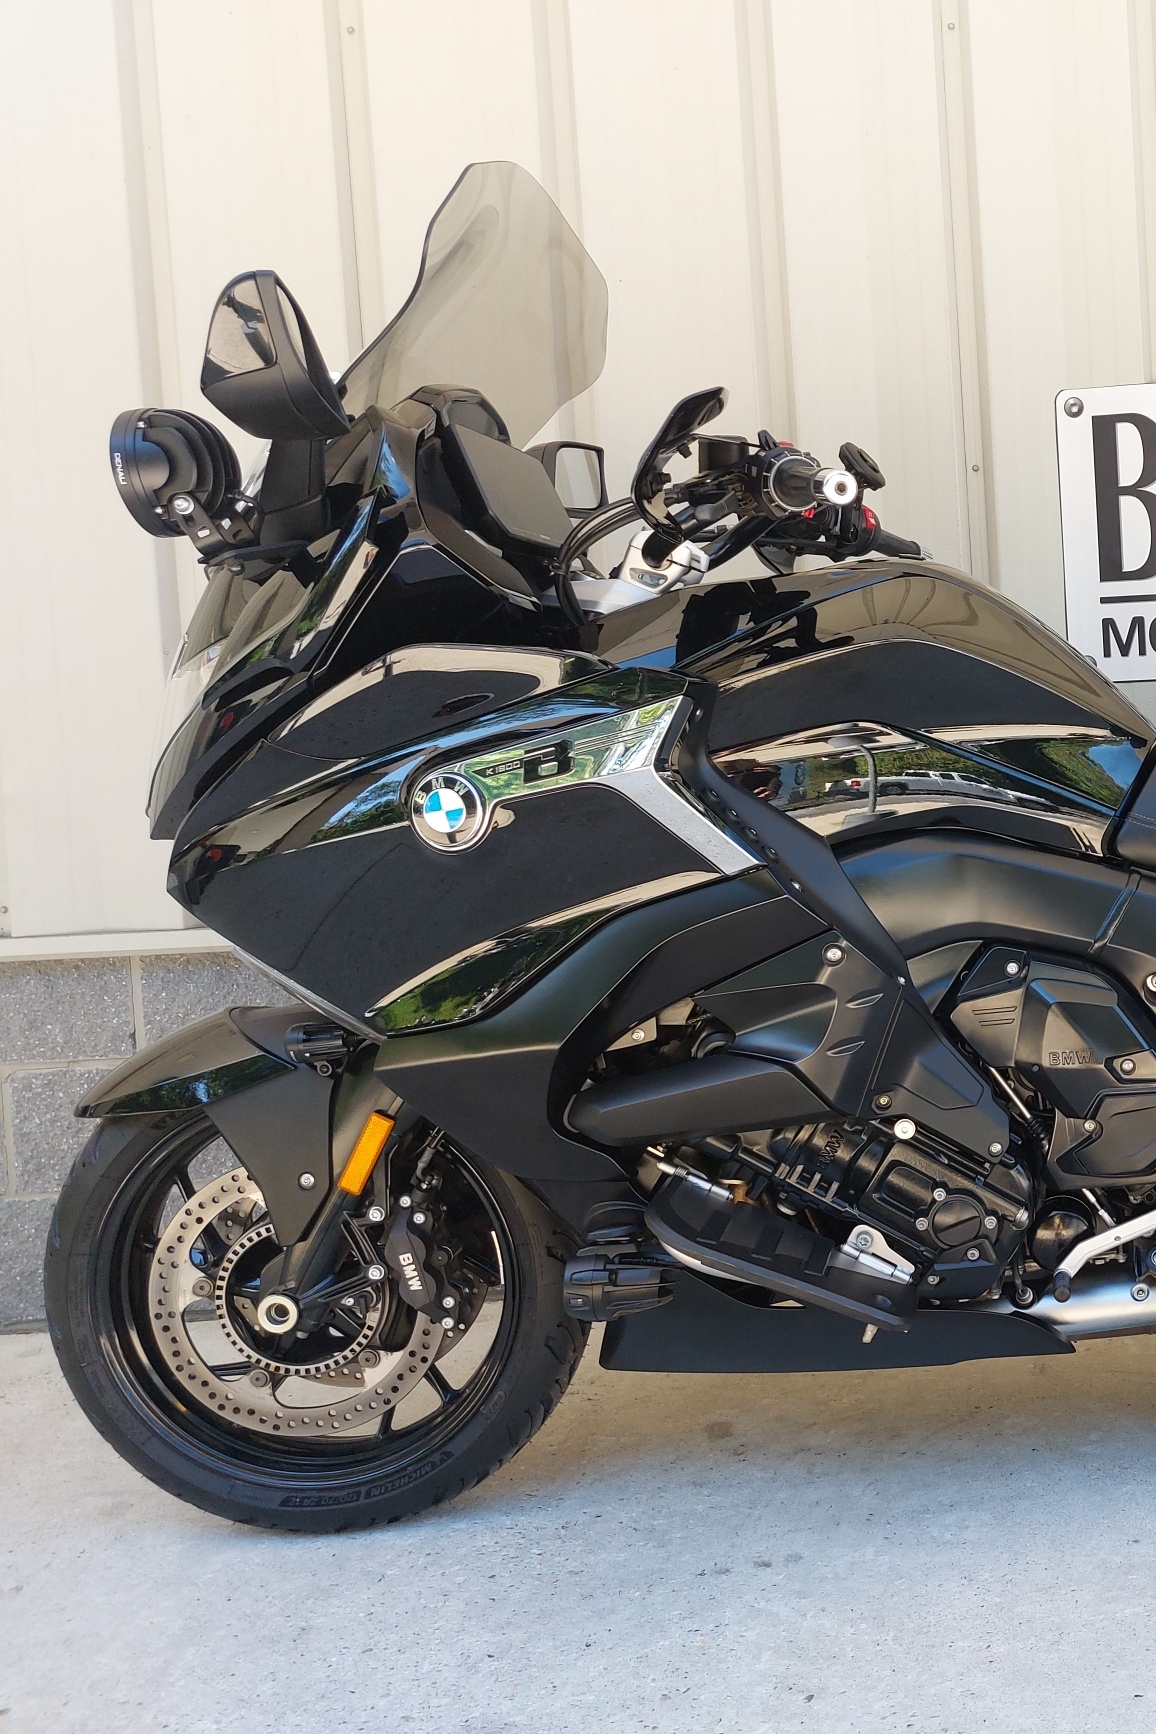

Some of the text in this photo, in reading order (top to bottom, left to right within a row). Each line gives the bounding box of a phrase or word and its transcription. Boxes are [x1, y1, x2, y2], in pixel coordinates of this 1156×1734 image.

[114, 453, 127, 484] DENALI
[414, 776, 469, 804] BMW
[1049, 1049, 1092, 1066] BMW
[399, 1253, 423, 1290] BMW
[370, 1463, 432, 1497] MICHELIN
